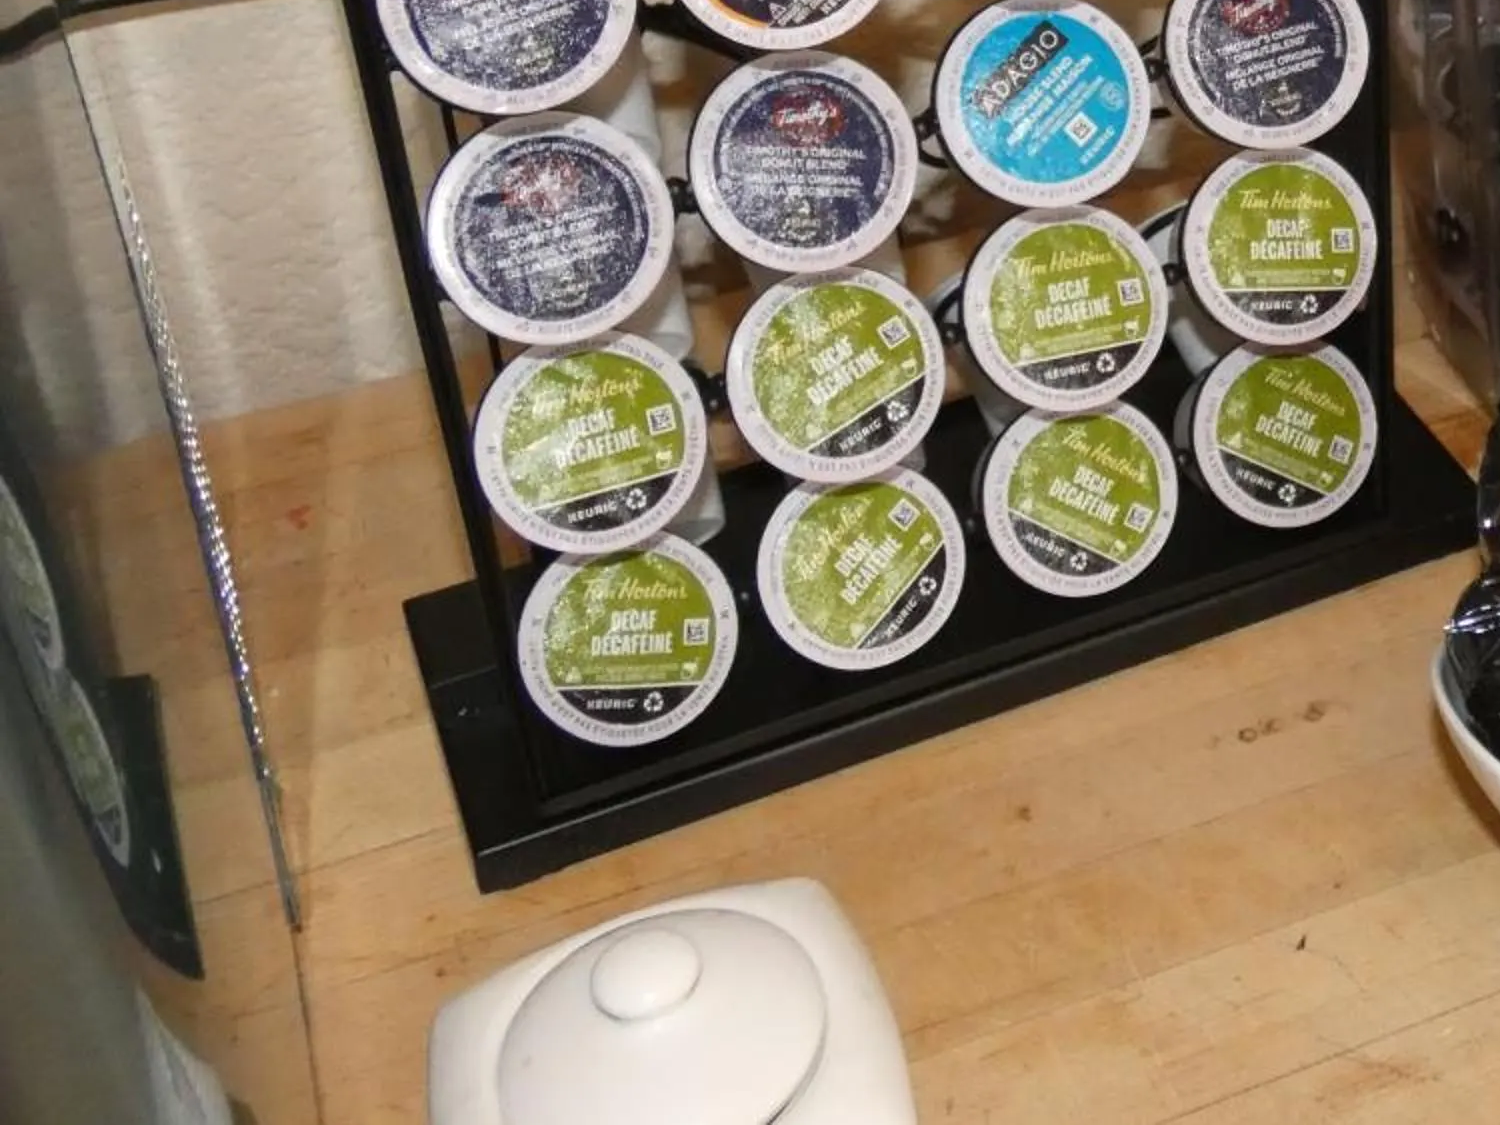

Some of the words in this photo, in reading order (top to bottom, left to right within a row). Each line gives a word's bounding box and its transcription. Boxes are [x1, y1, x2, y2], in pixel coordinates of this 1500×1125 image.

[974, 26, 1064, 116] ADAGIO
[1239, 188, 1268, 208] Tim
[1266, 218, 1305, 237] DECAF
[1047, 276, 1092, 303] DECAF
[565, 406, 619, 439] DECAF
[1275, 400, 1317, 432] DECAF
[837, 416, 885, 452] KEURIG
[1071, 463, 1115, 498] DECAF
[565, 498, 618, 523] KEURIG
[831, 531, 877, 578] DECAF
[617, 575, 688, 600] Hortons
[611, 609, 658, 632] DECAF
[586, 697, 638, 709] KEURIG
